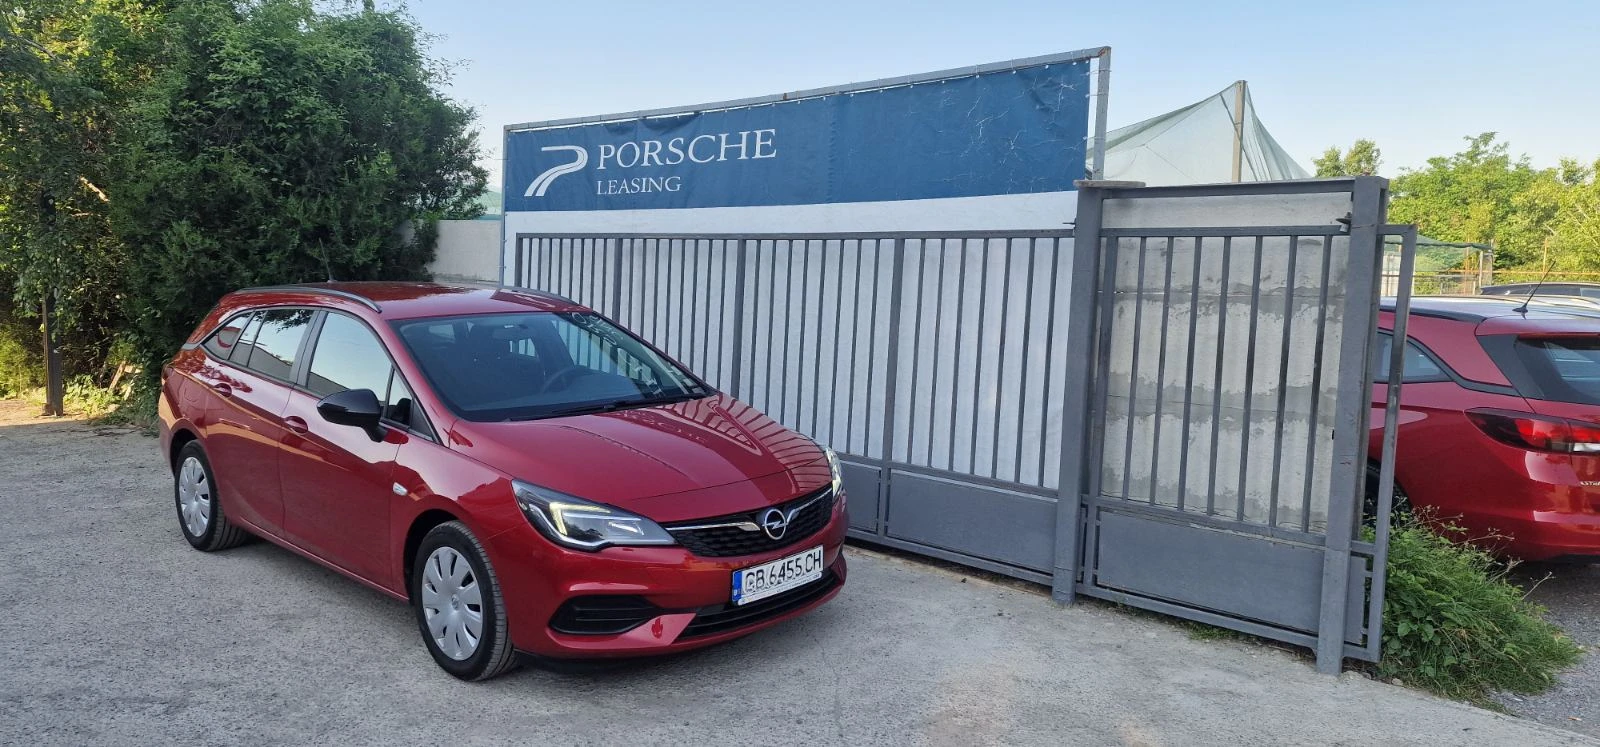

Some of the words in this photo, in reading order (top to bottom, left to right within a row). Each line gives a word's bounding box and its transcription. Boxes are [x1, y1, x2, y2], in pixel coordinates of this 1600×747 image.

[597, 128, 777, 170] PORSCHE
[597, 176, 681, 195] LEASING
[769, 557, 802, 585] 6455
[805, 550, 821, 573] CH
